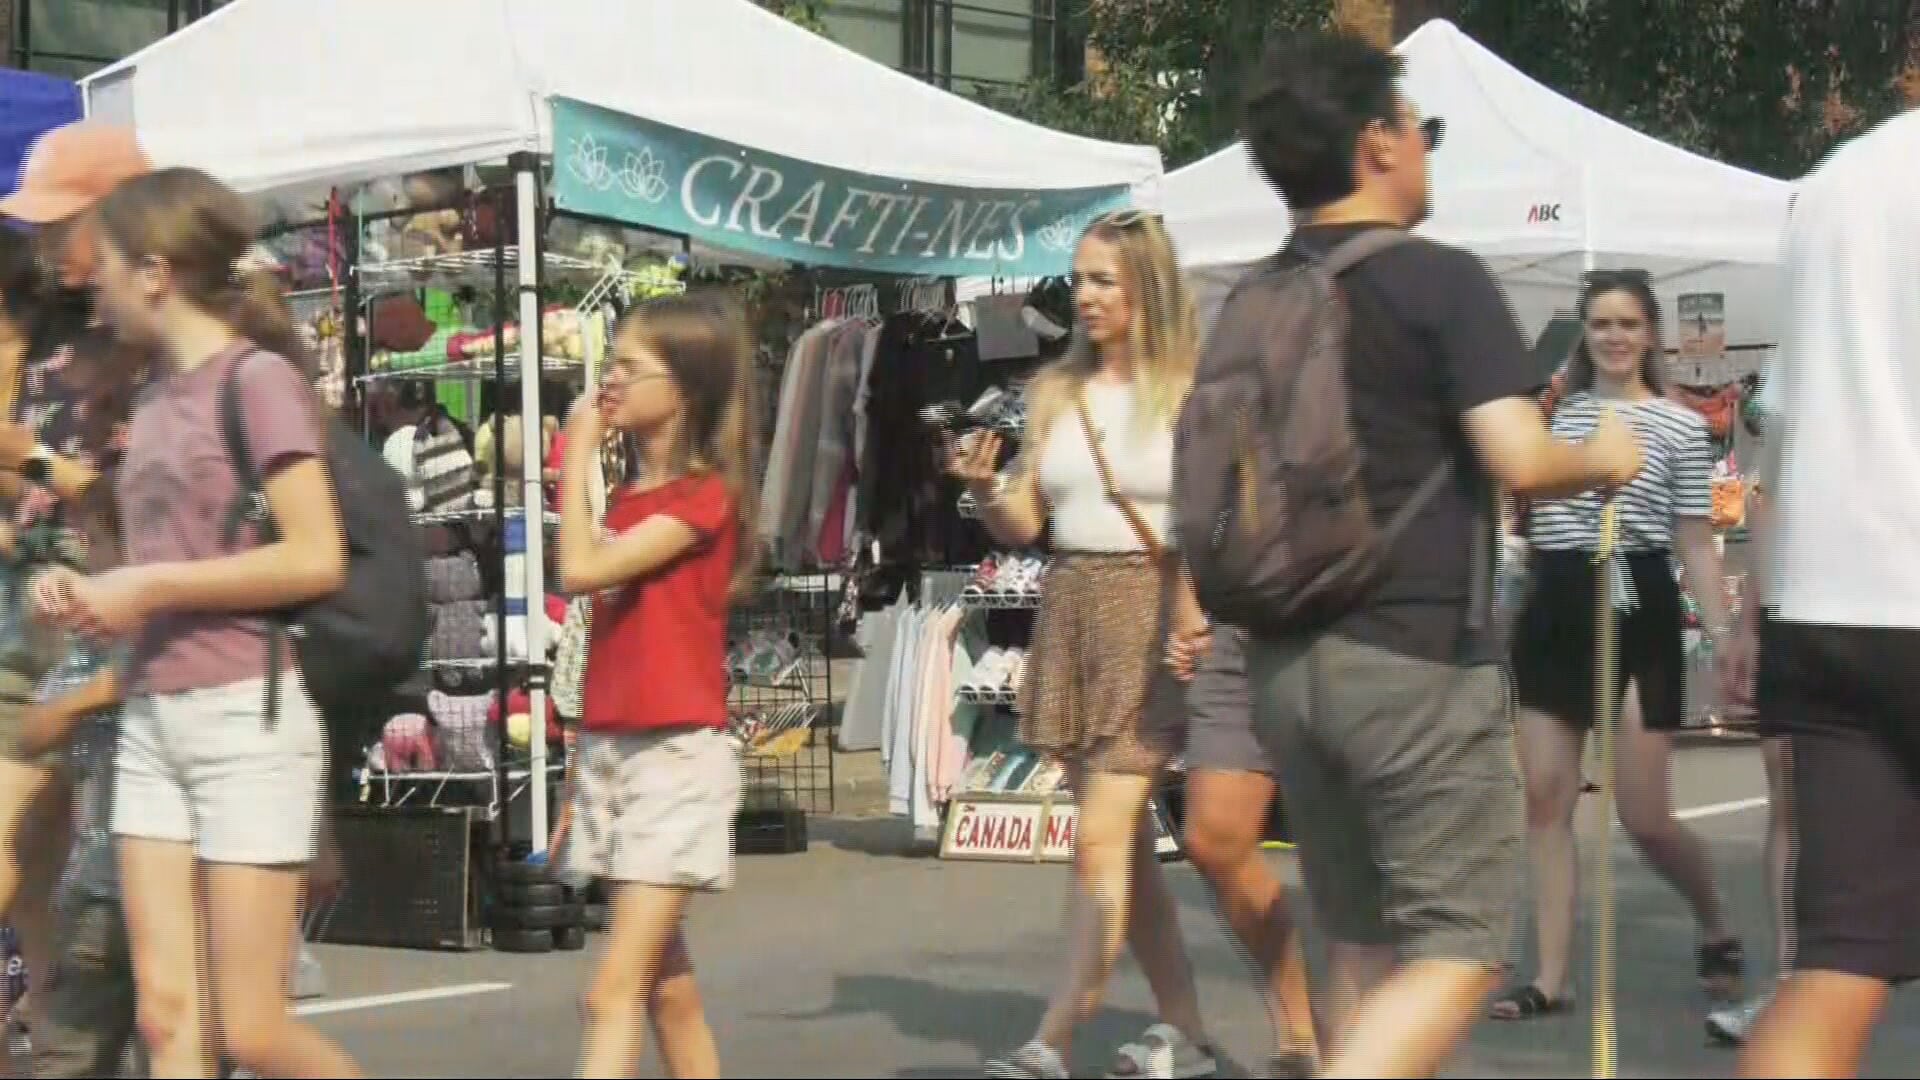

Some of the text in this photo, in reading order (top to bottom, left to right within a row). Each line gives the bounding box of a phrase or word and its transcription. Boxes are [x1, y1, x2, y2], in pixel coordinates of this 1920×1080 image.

[680, 156, 1040, 261] CRAFTI-NES
[1527, 203, 1561, 224] ABC
[955, 815, 1032, 850] CANADA
